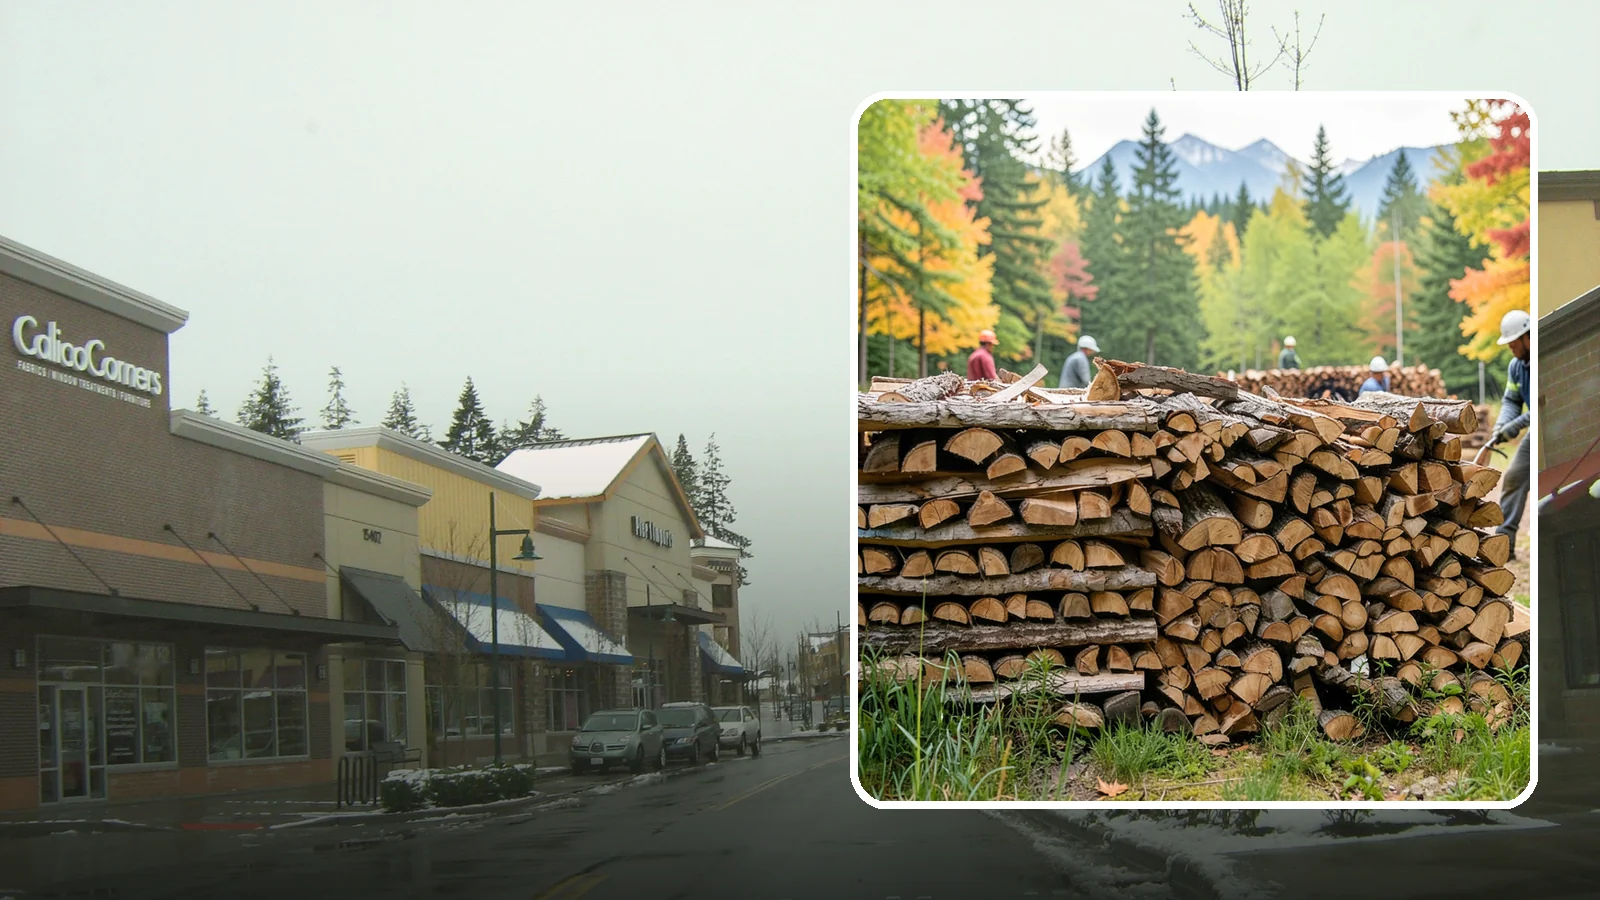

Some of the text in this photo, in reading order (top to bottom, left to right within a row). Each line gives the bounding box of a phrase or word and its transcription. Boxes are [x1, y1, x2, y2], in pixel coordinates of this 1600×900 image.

[17, 360, 151, 408] FABRICS WINDOW TREATMENTS FURNITURE
